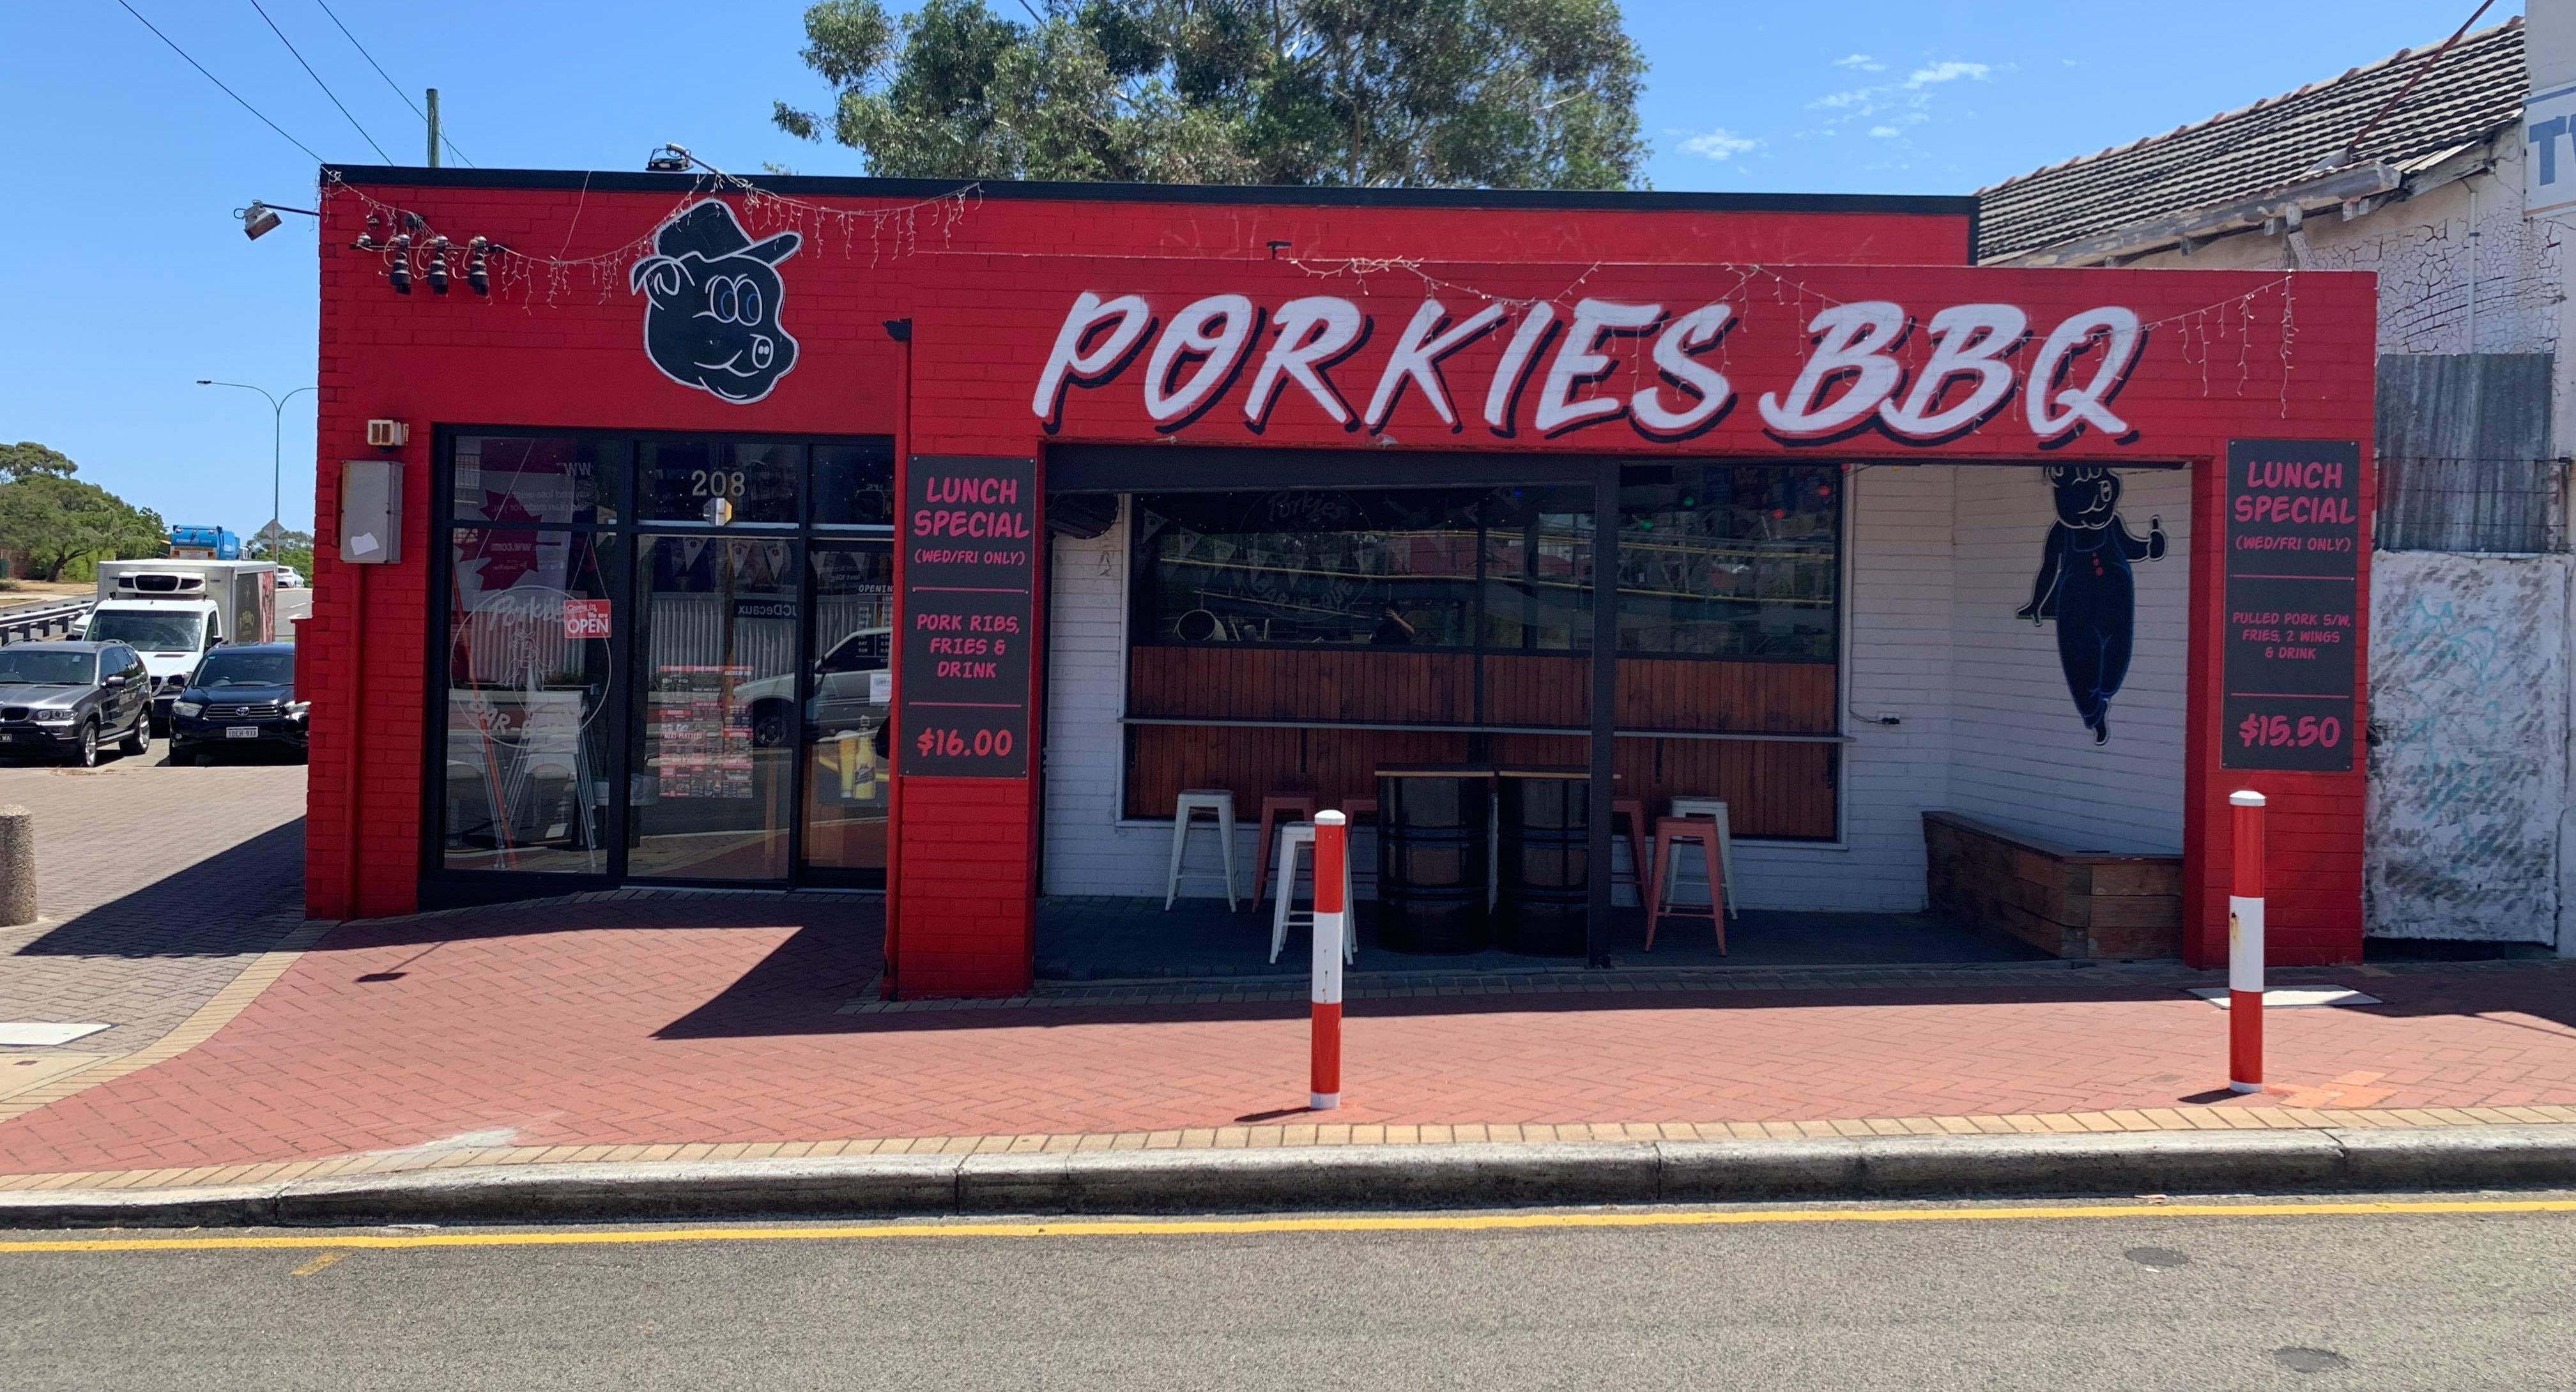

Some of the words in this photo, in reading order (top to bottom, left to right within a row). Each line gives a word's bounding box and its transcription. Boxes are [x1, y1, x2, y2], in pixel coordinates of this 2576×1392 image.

[2529, 114, 2576, 186] T
[1032, 291, 1735, 438] PORKIES
[1758, 300, 2144, 445] BBQ
[691, 470, 746, 497] 208
[2248, 461, 2342, 489] LUNCH
[926, 477, 1017, 504] LUNCH
[2235, 495, 2356, 524] SPECIAL
[914, 510, 1030, 538] SPECIAL
[2236, 535, 2301, 551] (WED/FRI
[2307, 537, 2351, 551] ONLY)
[915, 549, 977, 563] (WED/FRI
[984, 551, 1025, 565] ONLY)
[858, 584, 894, 593] OPENIN
[489, 595, 564, 631] Porkie
[917, 614, 962, 631] PORK
[970, 615, 1020, 634] RIBS,
[2233, 612, 2280, 624] PULLED
[2284, 613, 2317, 625] PORK
[2323, 614, 2351, 627] S/W,
[567, 618, 609, 634] OPEN
[2242, 629, 2281, 643] FRIES,
[2286, 630, 2295, 643] 2
[2299, 631, 2340, 643] WINGS
[930, 638, 988, 655] FRIES
[993, 639, 1006, 656] &
[2264, 646, 2274, 659] &
[2279, 647, 2317, 659] DRINK
[937, 661, 997, 678] DRINK
[2239, 713, 2341, 747] $15.50
[917, 727, 1013, 757] $16.00
